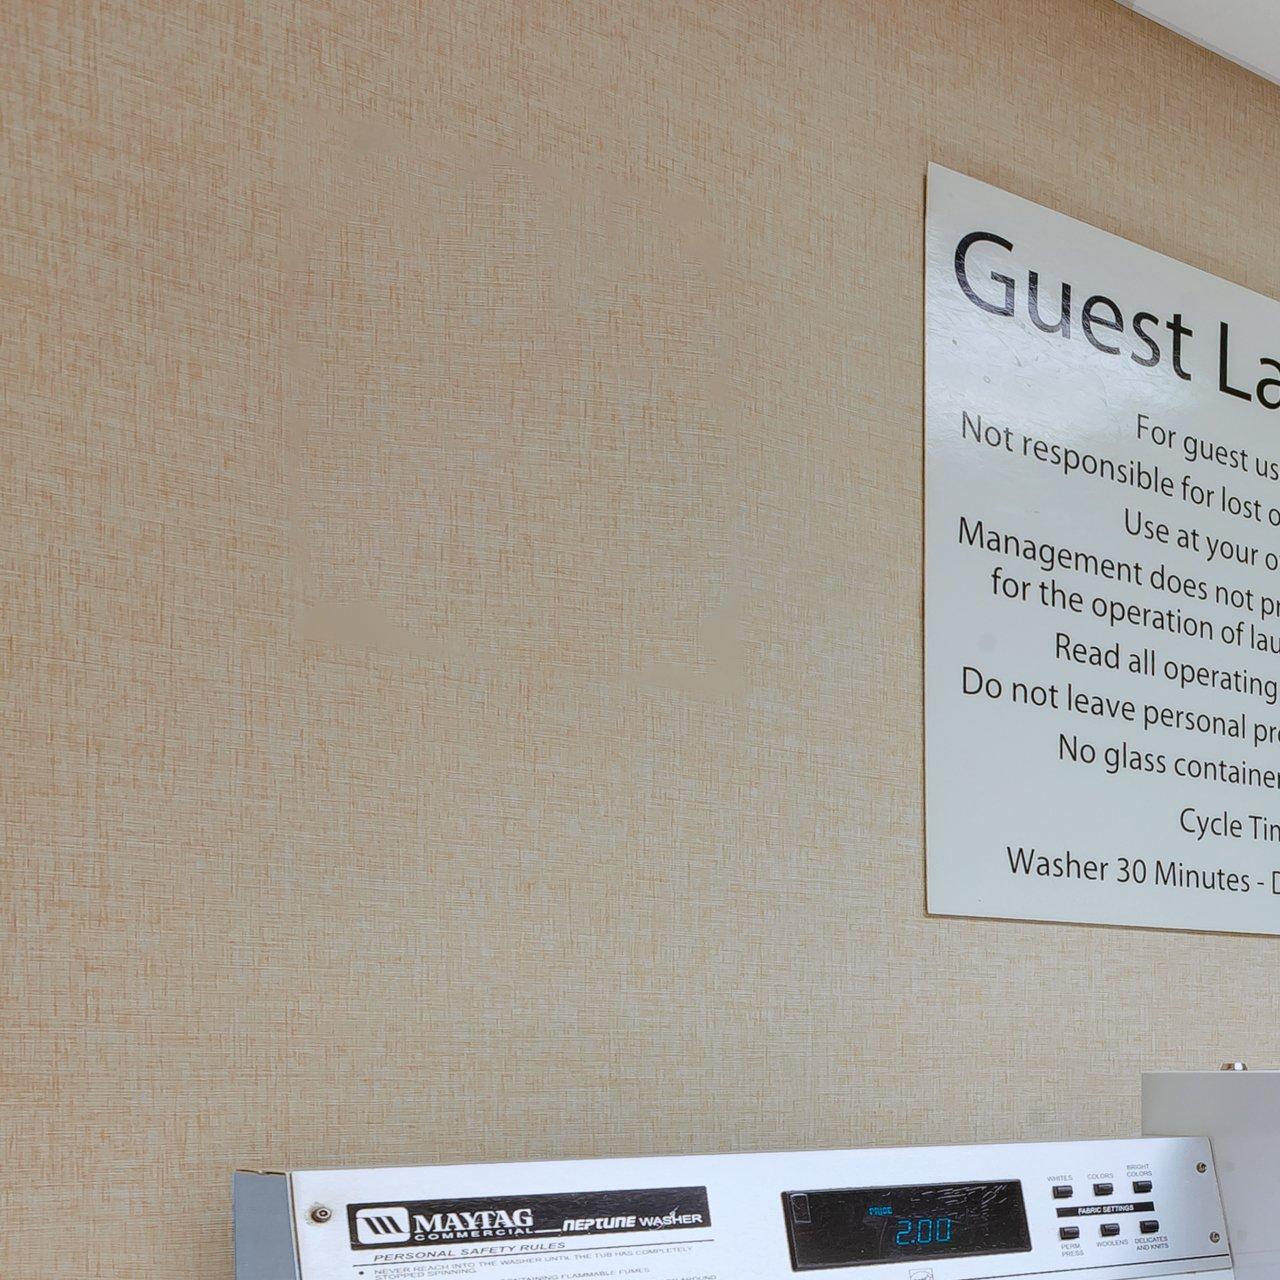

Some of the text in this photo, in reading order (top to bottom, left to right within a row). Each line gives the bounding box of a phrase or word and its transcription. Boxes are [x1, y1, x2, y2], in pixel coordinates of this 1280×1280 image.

[953, 230, 1192, 381] Guest
[1136, 413, 1176, 448] For
[1183, 435, 1248, 472] guest
[962, 410, 1013, 452] Not
[1023, 435, 1173, 497] responsible
[1180, 474, 1214, 507] for
[1222, 485, 1261, 522] lost
[1124, 507, 1169, 543] Use
[1176, 528, 1199, 552] at
[1205, 536, 1258, 565] your
[958, 516, 1142, 586] Management
[1150, 563, 1207, 600] does
[1215, 585, 1253, 611] not
[991, 566, 1031, 601] for
[1038, 579, 1083, 612] the
[1091, 597, 1212, 640] operation
[1220, 620, 1244, 646] of
[1055, 632, 1119, 669] Read
[1128, 648, 1154, 676] all
[1163, 660, 1277, 705] operating
[962, 665, 1002, 698] Do
[1012, 682, 1058, 709] not
[1067, 683, 1135, 721] leave
[1144, 704, 1245, 738] personal
[1059, 733, 1095, 763] No
[1104, 741, 1166, 774] glass
[1179, 807, 1242, 841] Cycle
[1006, 846, 1108, 880] Washer
[1116, 857, 1146, 883] 30
[1155, 859, 1250, 892] Minutes
[411, 1208, 534, 1233] MAYTAG
[638, 1213, 702, 1226] WASHER
[896, 1218, 951, 1245] 2.00
[1078, 1204, 1134, 1215] FABRIC SETTINGS
[372, 1241, 565, 1262] PERSONAL SAFETY RULES
[414, 1227, 533, 1241] COMMERCIAL
